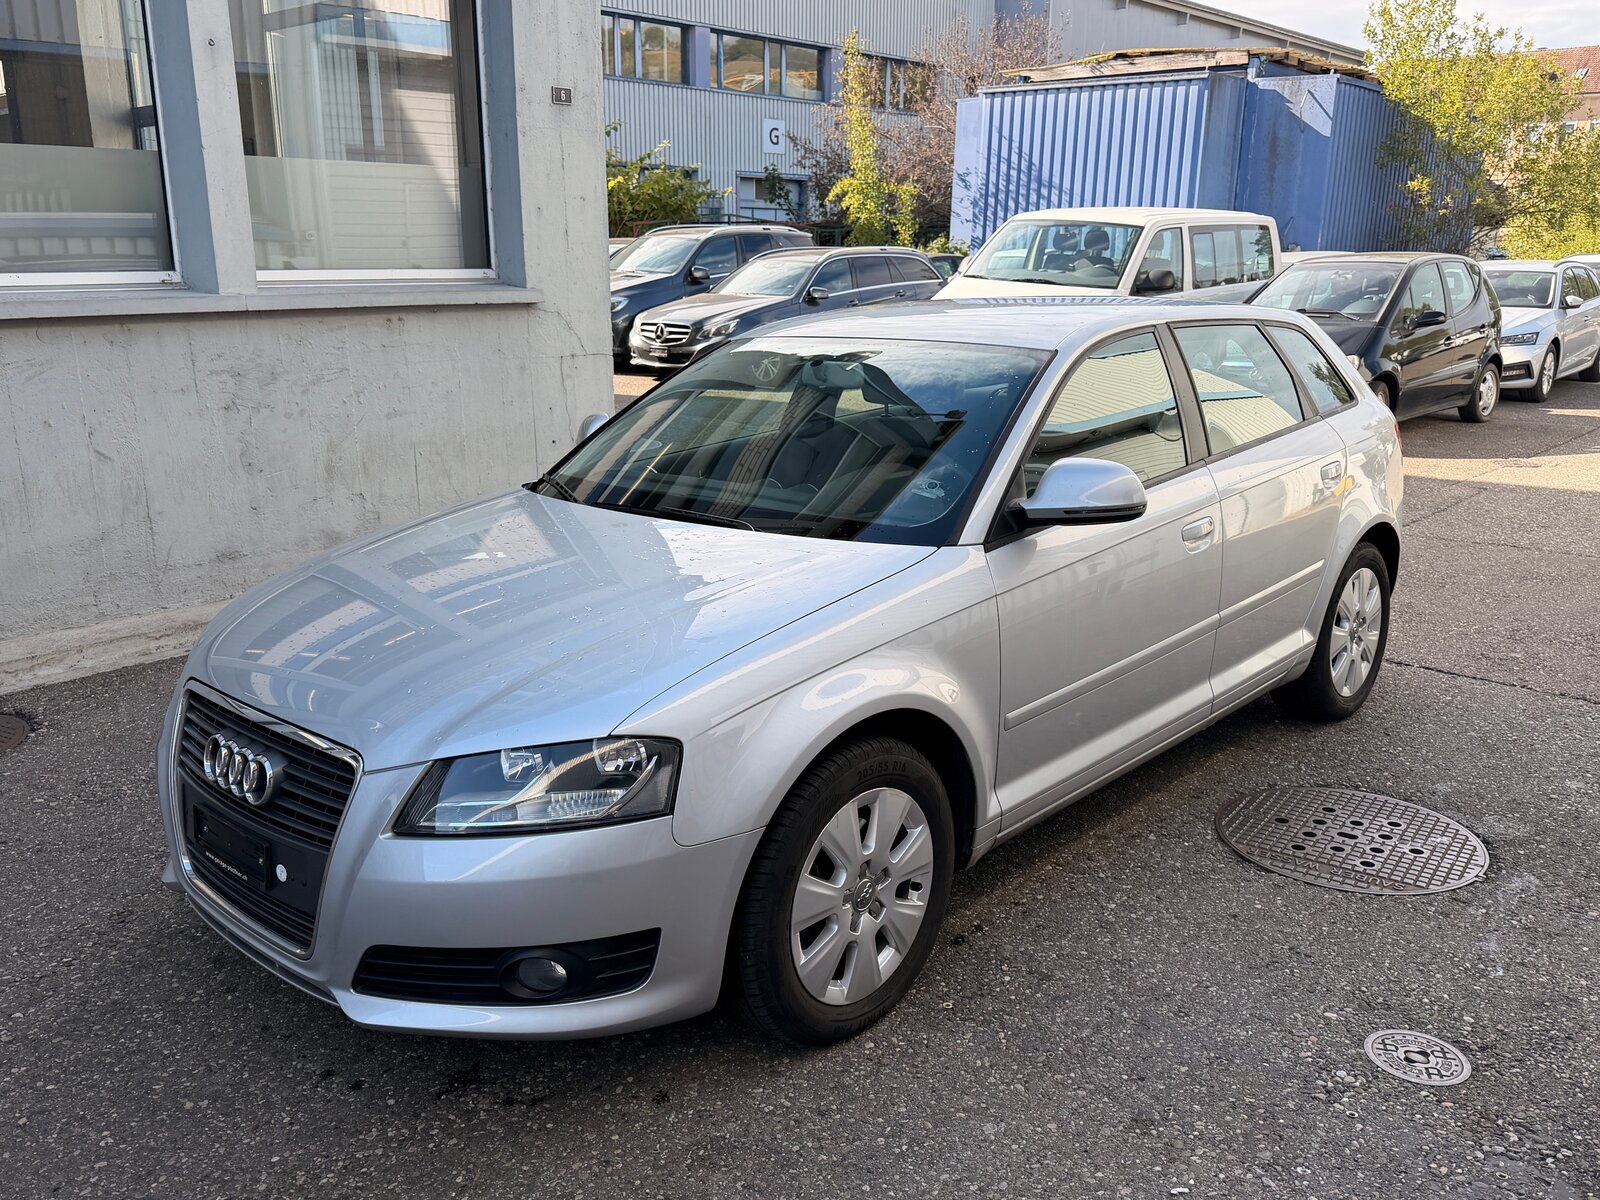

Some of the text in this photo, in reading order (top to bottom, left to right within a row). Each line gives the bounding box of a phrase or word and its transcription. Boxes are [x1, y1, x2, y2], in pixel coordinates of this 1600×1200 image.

[560, 90, 566, 101] 6
[769, 127, 780, 146] G
[857, 761, 889, 781] 205/55
[1247, 848, 1405, 891] SAUBER WASSER
